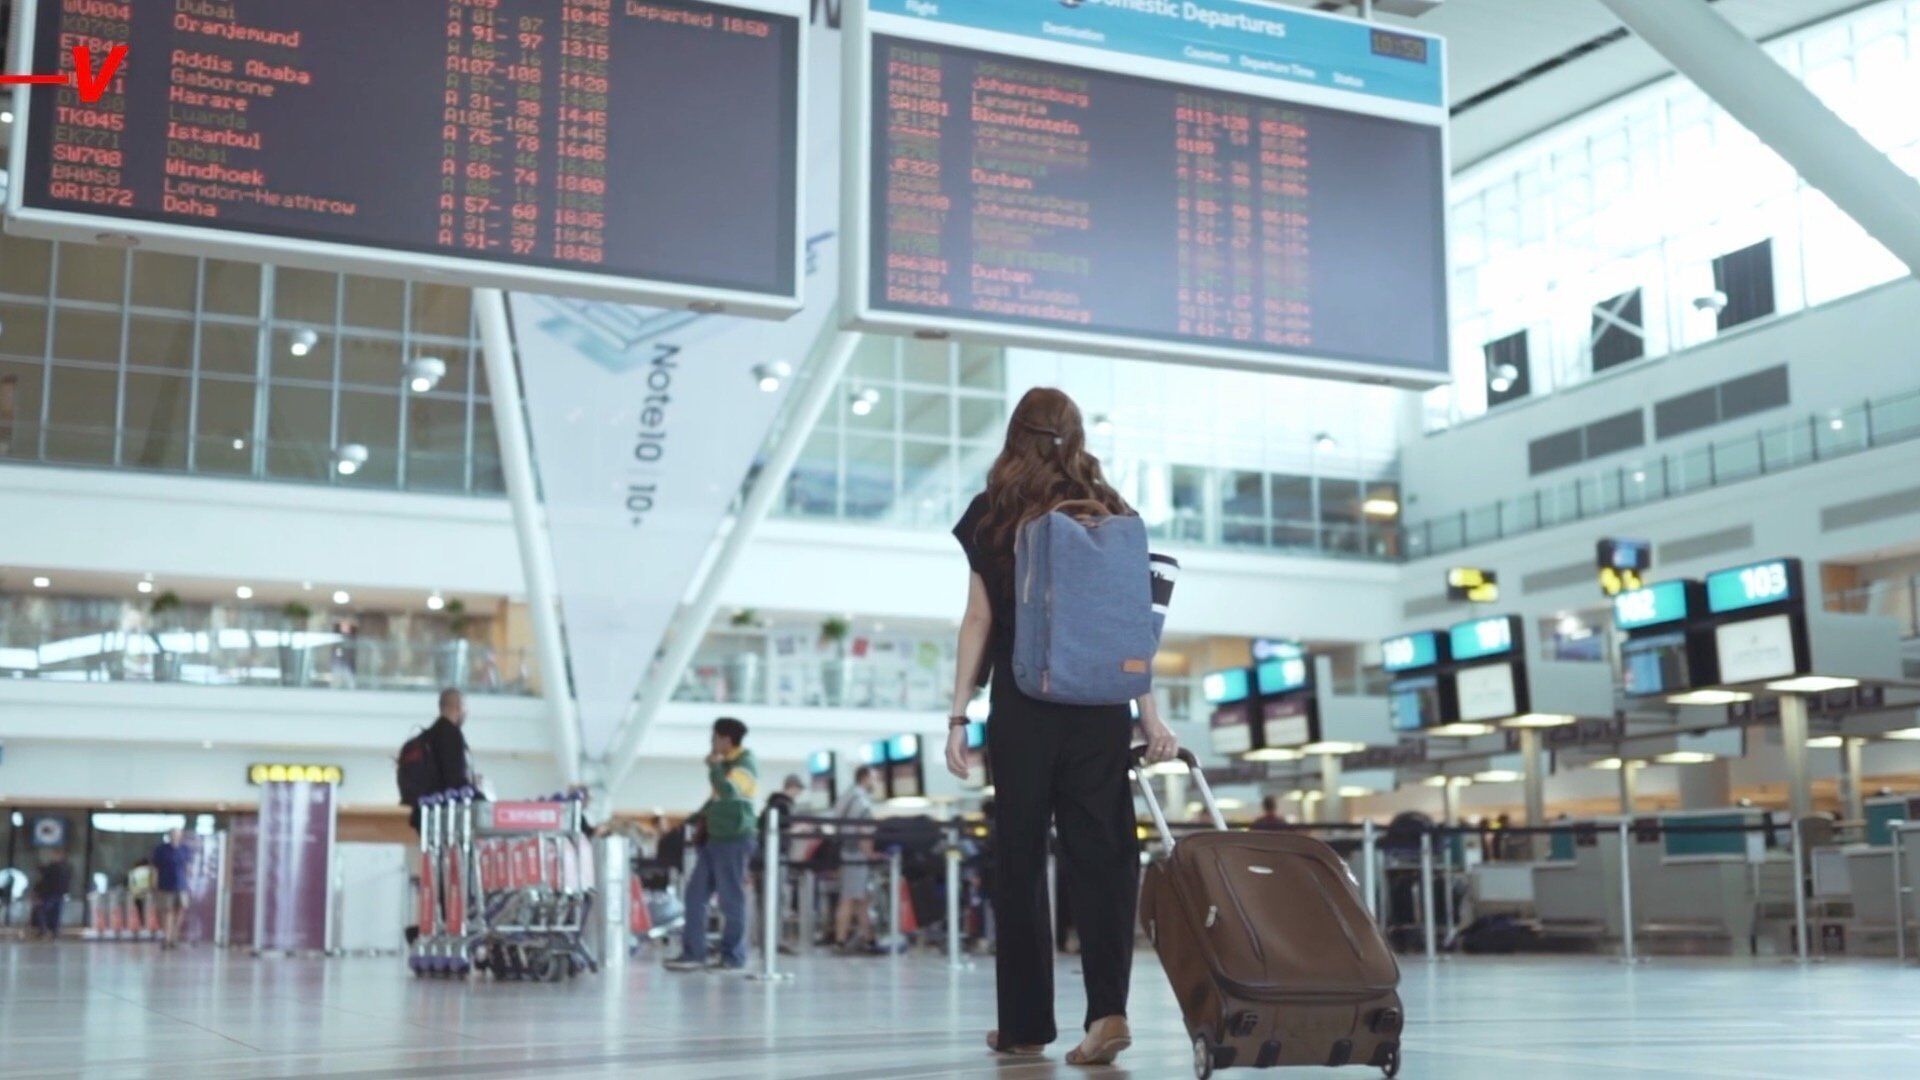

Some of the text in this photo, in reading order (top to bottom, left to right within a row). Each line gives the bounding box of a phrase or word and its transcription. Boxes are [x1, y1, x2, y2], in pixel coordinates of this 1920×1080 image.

[626, 1, 713, 27] Departed
[1183, 2, 1285, 38] Departures
[174, 14, 299, 47] Oranjemund
[172, 50, 310, 85] Addis Ababa
[171, 68, 274, 97] Gaborone
[170, 86, 247, 110] Harare
[57, 107, 124, 131] TK045
[54, 125, 119, 149] EK771
[168, 122, 260, 150] Istanbul
[166, 158, 265, 186] Windhoek
[50, 182, 135, 207] QR1372
[163, 195, 217, 217] Doha
[164, 178, 356, 215] London-Heathrow
[633, 343, 682, 462] Note10
[1740, 563, 1788, 601] 103
